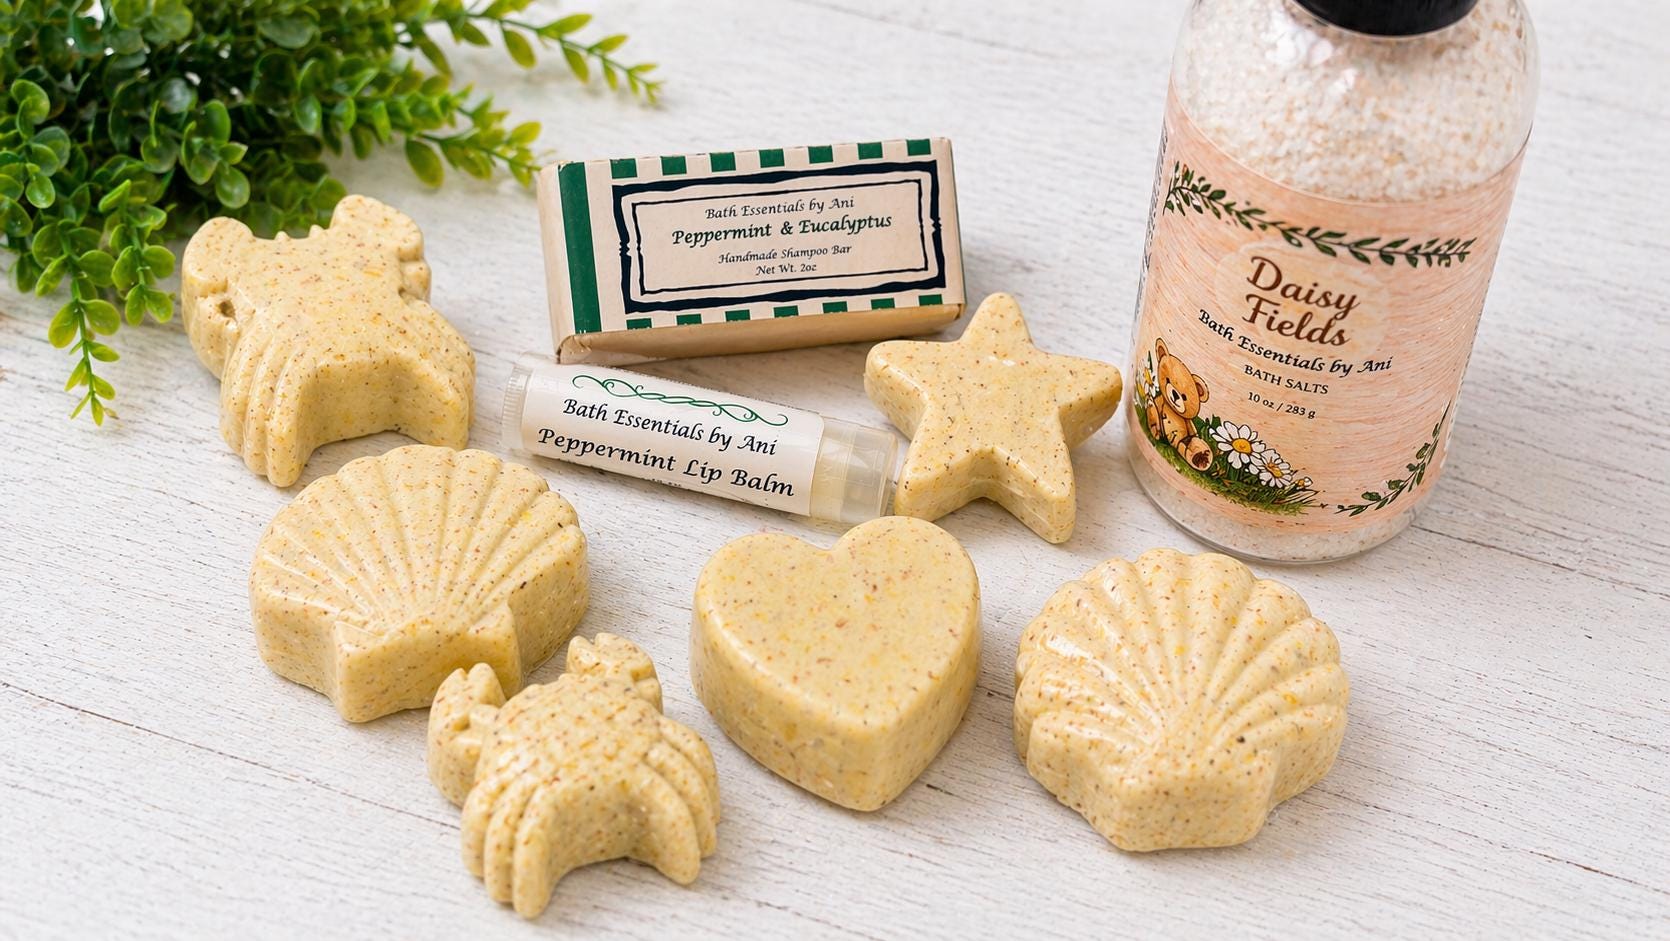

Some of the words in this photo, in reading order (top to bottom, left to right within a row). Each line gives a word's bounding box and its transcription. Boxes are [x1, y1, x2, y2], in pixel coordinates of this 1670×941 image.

[705, 205, 737, 219] Bath
[741, 200, 805, 216] Essentials
[809, 199, 825, 215] by
[828, 197, 854, 210] Ani
[672, 223, 771, 247] Peppermint
[780, 221, 793, 235] &
[799, 214, 892, 236] Eucalyptus
[718, 249, 777, 264] Handmade
[781, 247, 827, 260] Shampoo
[831, 244, 851, 255] Bar
[756, 266, 775, 276] Net
[778, 264, 797, 273] Wt.
[800, 263, 816, 272] 2oz
[1246, 255, 1360, 321] Daisy
[1241, 294, 1351, 347] Fields
[1198, 309, 1234, 342] Bath
[1238, 335, 1324, 371] Essentials
[1329, 359, 1352, 378] by
[1357, 356, 1393, 374] Ani
[1244, 364, 1282, 386] BATH
[1285, 378, 1329, 395] SALTS
[1248, 392, 1260, 403] 10
[1262, 400, 1274, 408] oz
[1276, 402, 1284, 412] /
[1285, 404, 1306, 416] 283
[1308, 409, 1316, 419] g
[563, 398, 607, 422] Bath
[612, 408, 705, 441] Essentials
[708, 426, 733, 451] by
[737, 435, 777, 456] Ani
[538, 428, 676, 471] Peppermint
[682, 460, 723, 485] Lip
[730, 469, 794, 497] Balm
